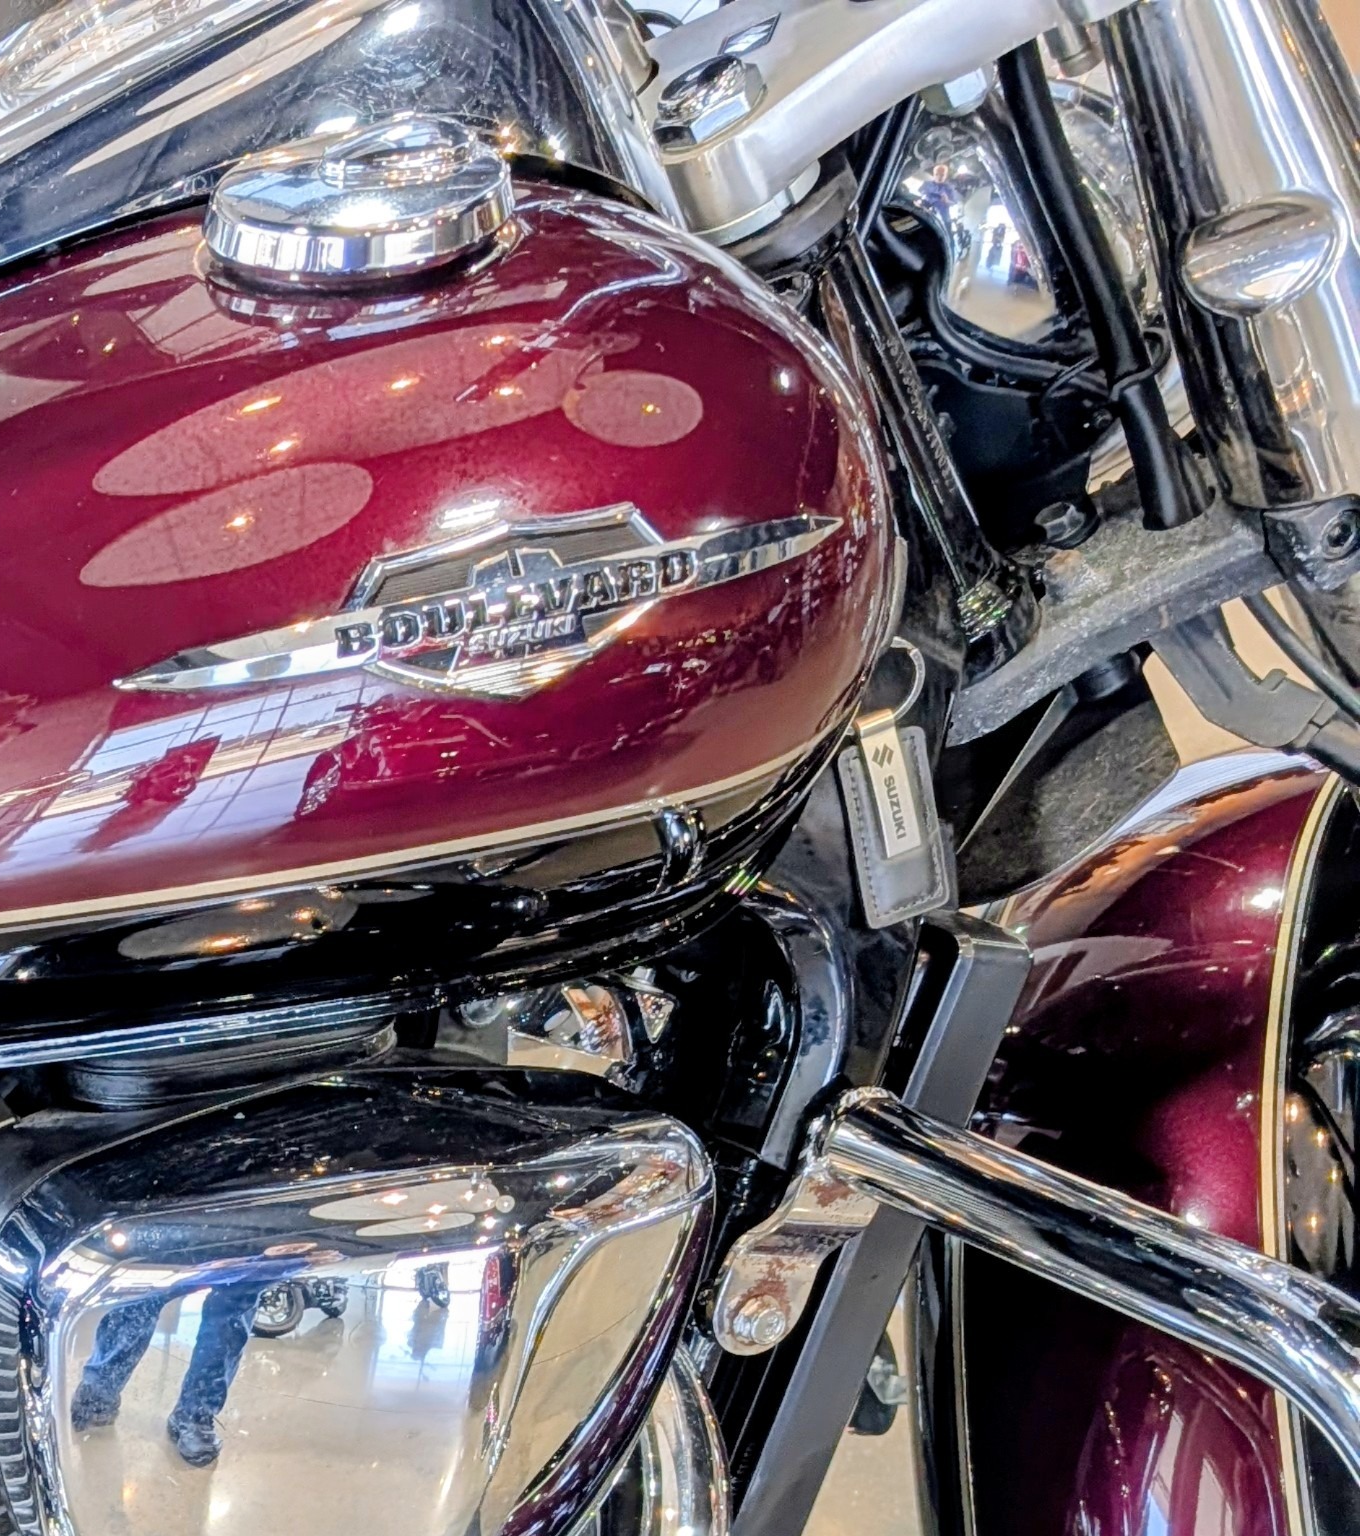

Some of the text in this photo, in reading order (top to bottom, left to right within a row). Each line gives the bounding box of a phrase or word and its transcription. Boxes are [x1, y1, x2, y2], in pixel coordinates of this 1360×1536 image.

[335, 550, 698, 659] BOULEVARD
[468, 613, 576, 656] SUZUKI
[883, 774, 908, 840] SUZUKI
